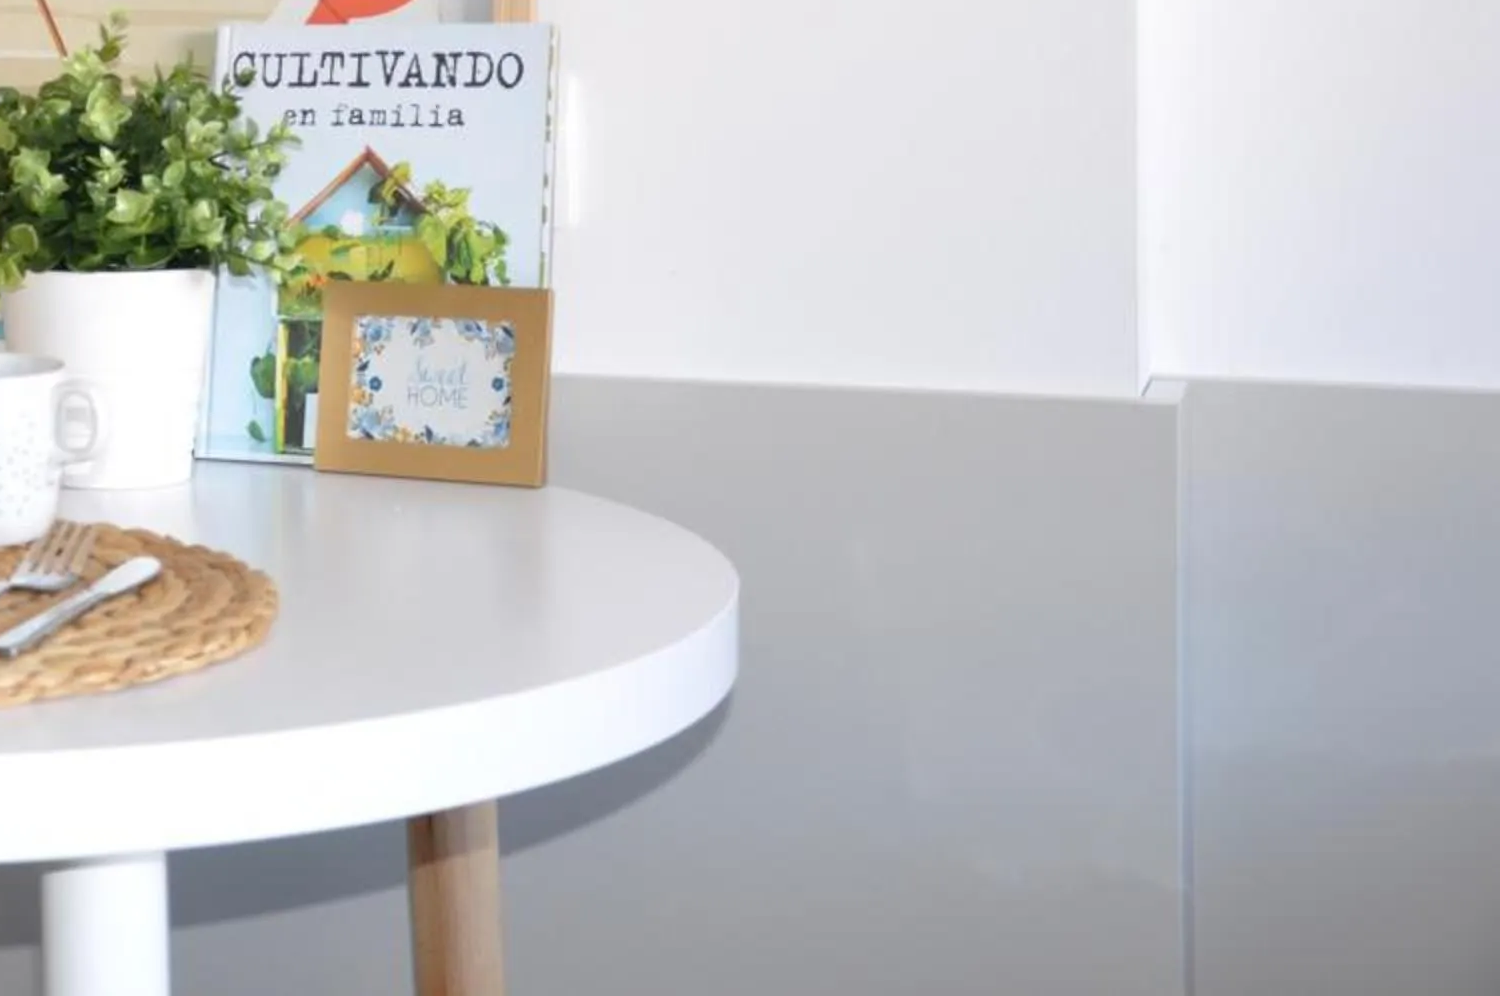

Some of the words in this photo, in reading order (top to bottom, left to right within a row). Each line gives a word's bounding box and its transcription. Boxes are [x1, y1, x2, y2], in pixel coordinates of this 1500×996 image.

[233, 51, 525, 89] CULTIVANDO
[284, 106, 316, 126] en
[330, 103, 466, 128] familia
[407, 384, 470, 409] HOME
